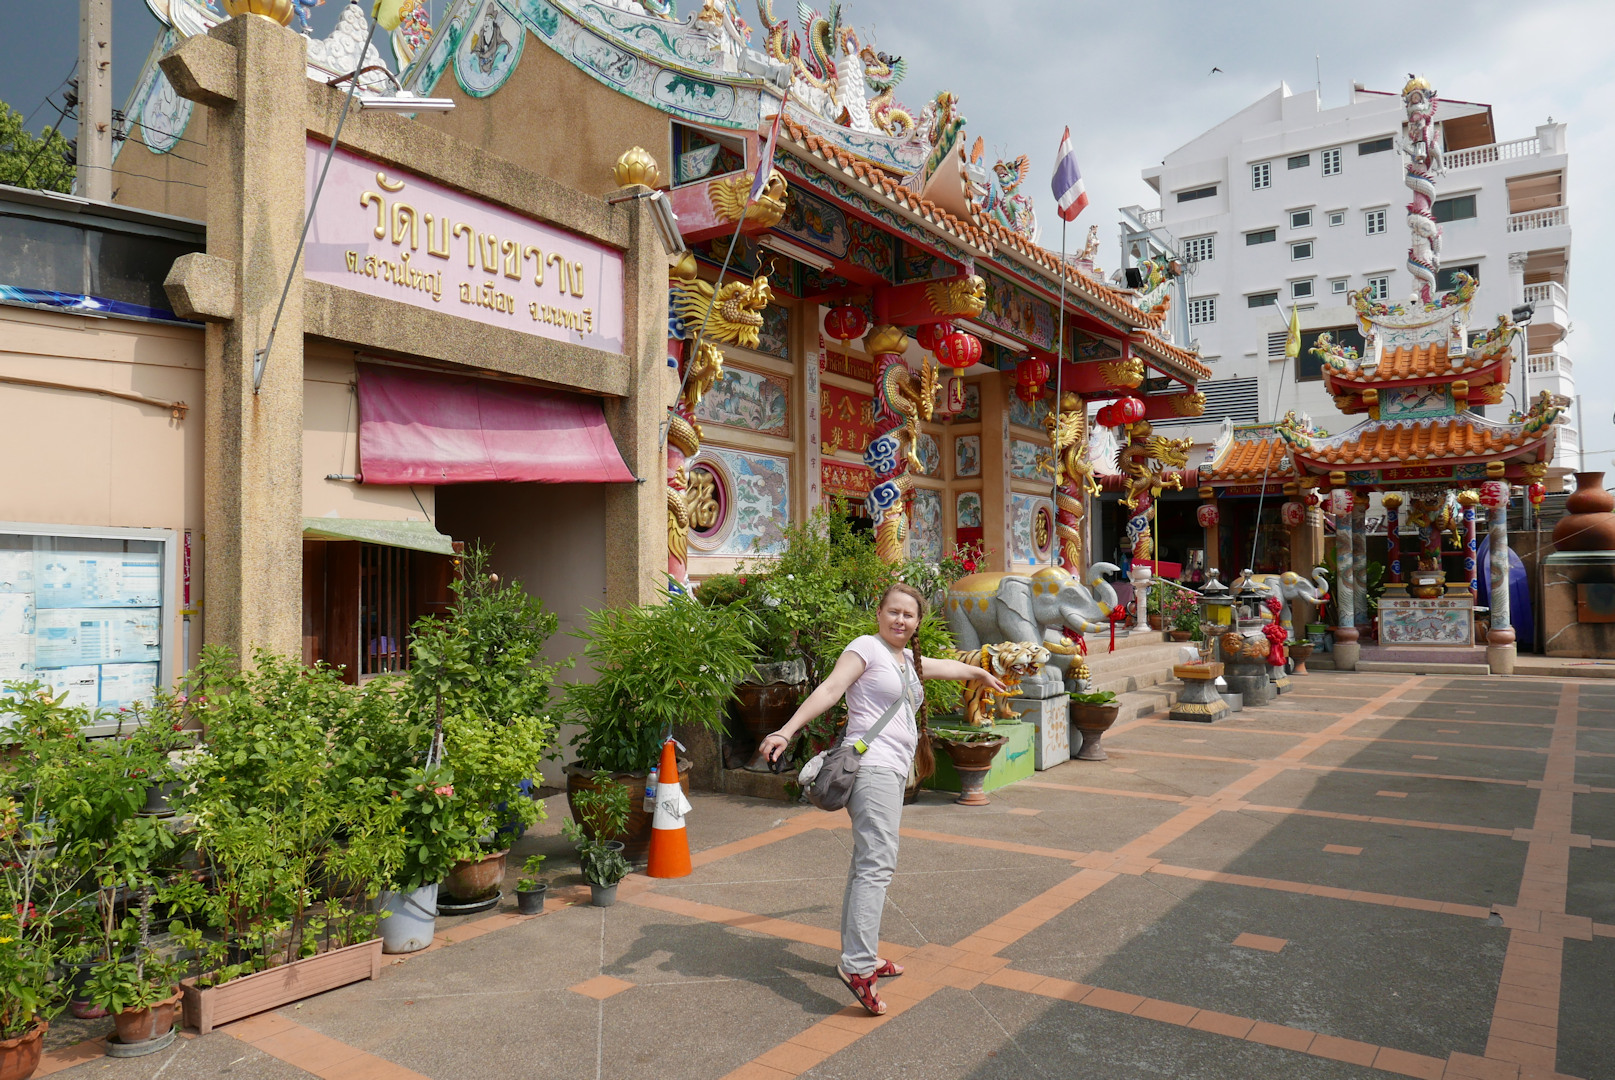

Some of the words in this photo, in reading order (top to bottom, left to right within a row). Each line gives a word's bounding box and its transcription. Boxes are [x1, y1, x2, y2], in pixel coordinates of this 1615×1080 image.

[360, 172, 584, 299] วัดบางขวาง
[345, 249, 442, 302] ต.สวนใหญ่
[459, 280, 515, 315] อ.เมือง
[529, 301, 593, 339] จ.นนทบุรี
